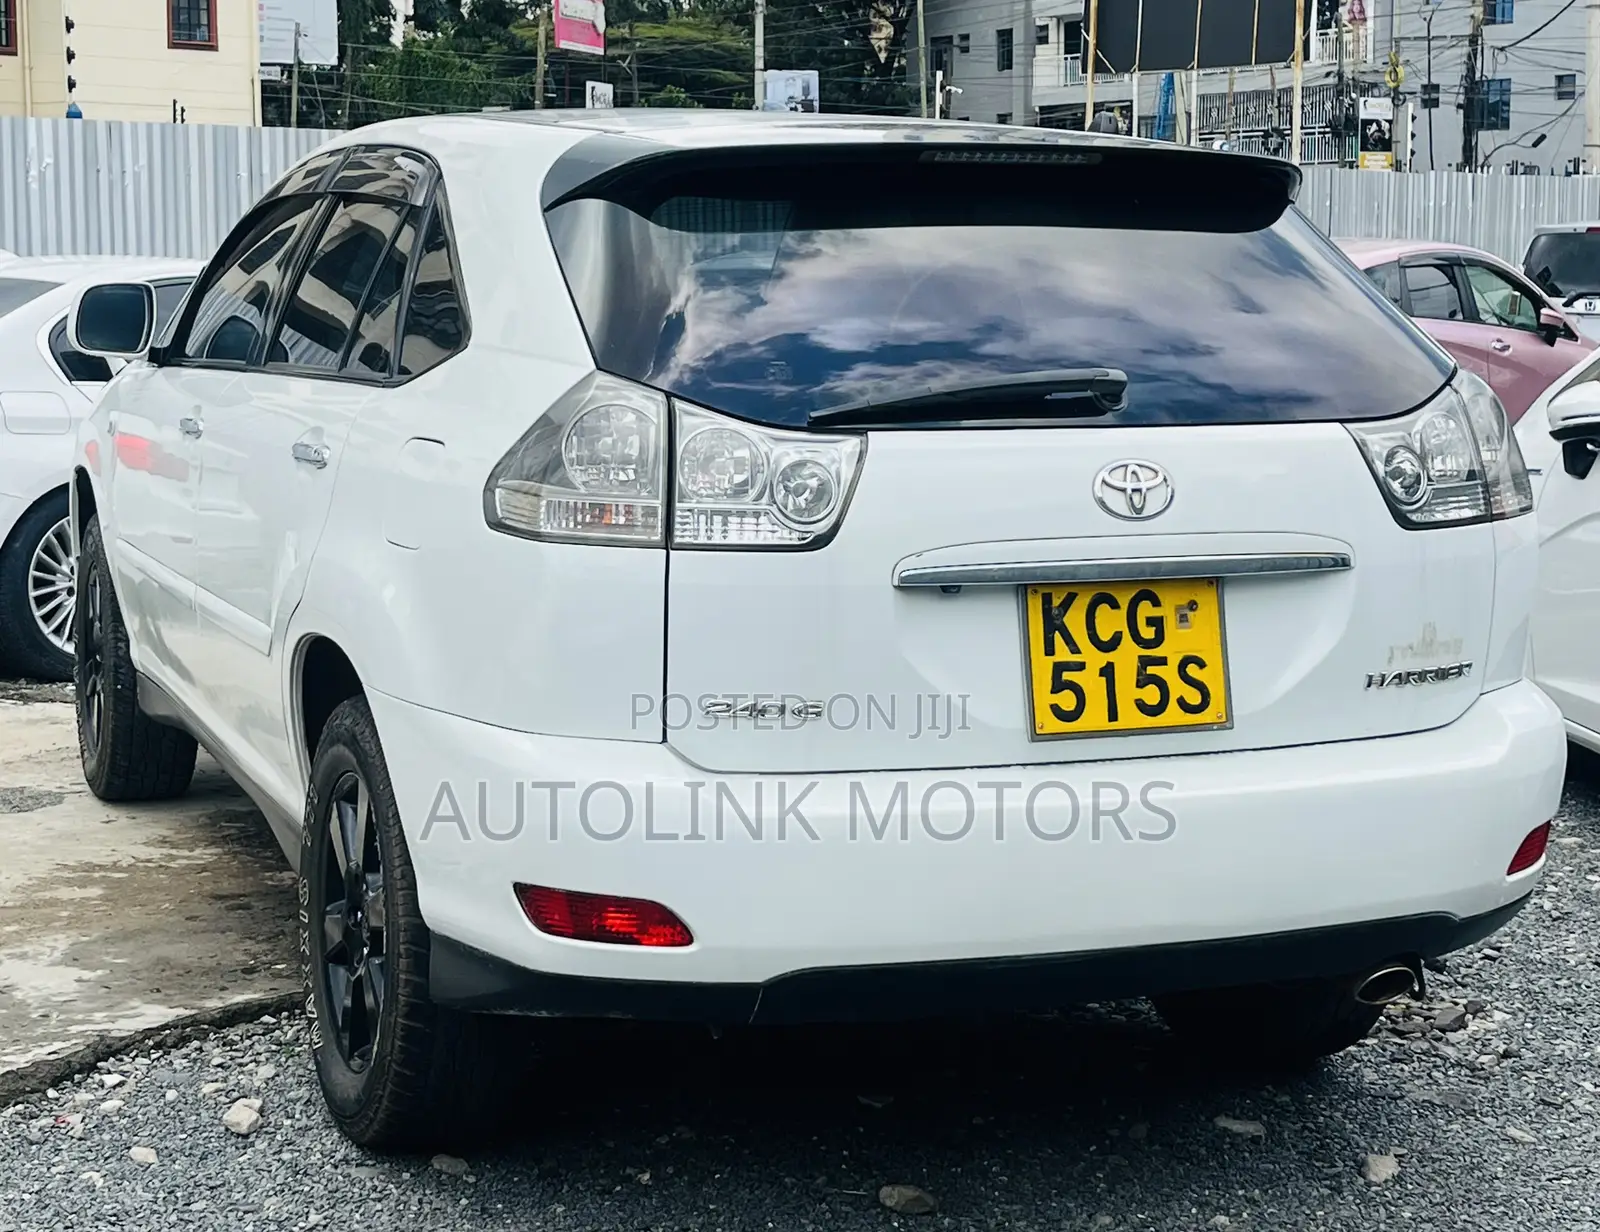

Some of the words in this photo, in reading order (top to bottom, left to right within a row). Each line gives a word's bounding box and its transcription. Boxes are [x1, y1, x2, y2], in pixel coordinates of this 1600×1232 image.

[1041, 588, 1166, 656] KCG
[1049, 655, 1212, 723] 515S
[1364, 660, 1473, 691] HARRIER
[704, 700, 785, 720] 240
[791, 700, 825, 719] G
